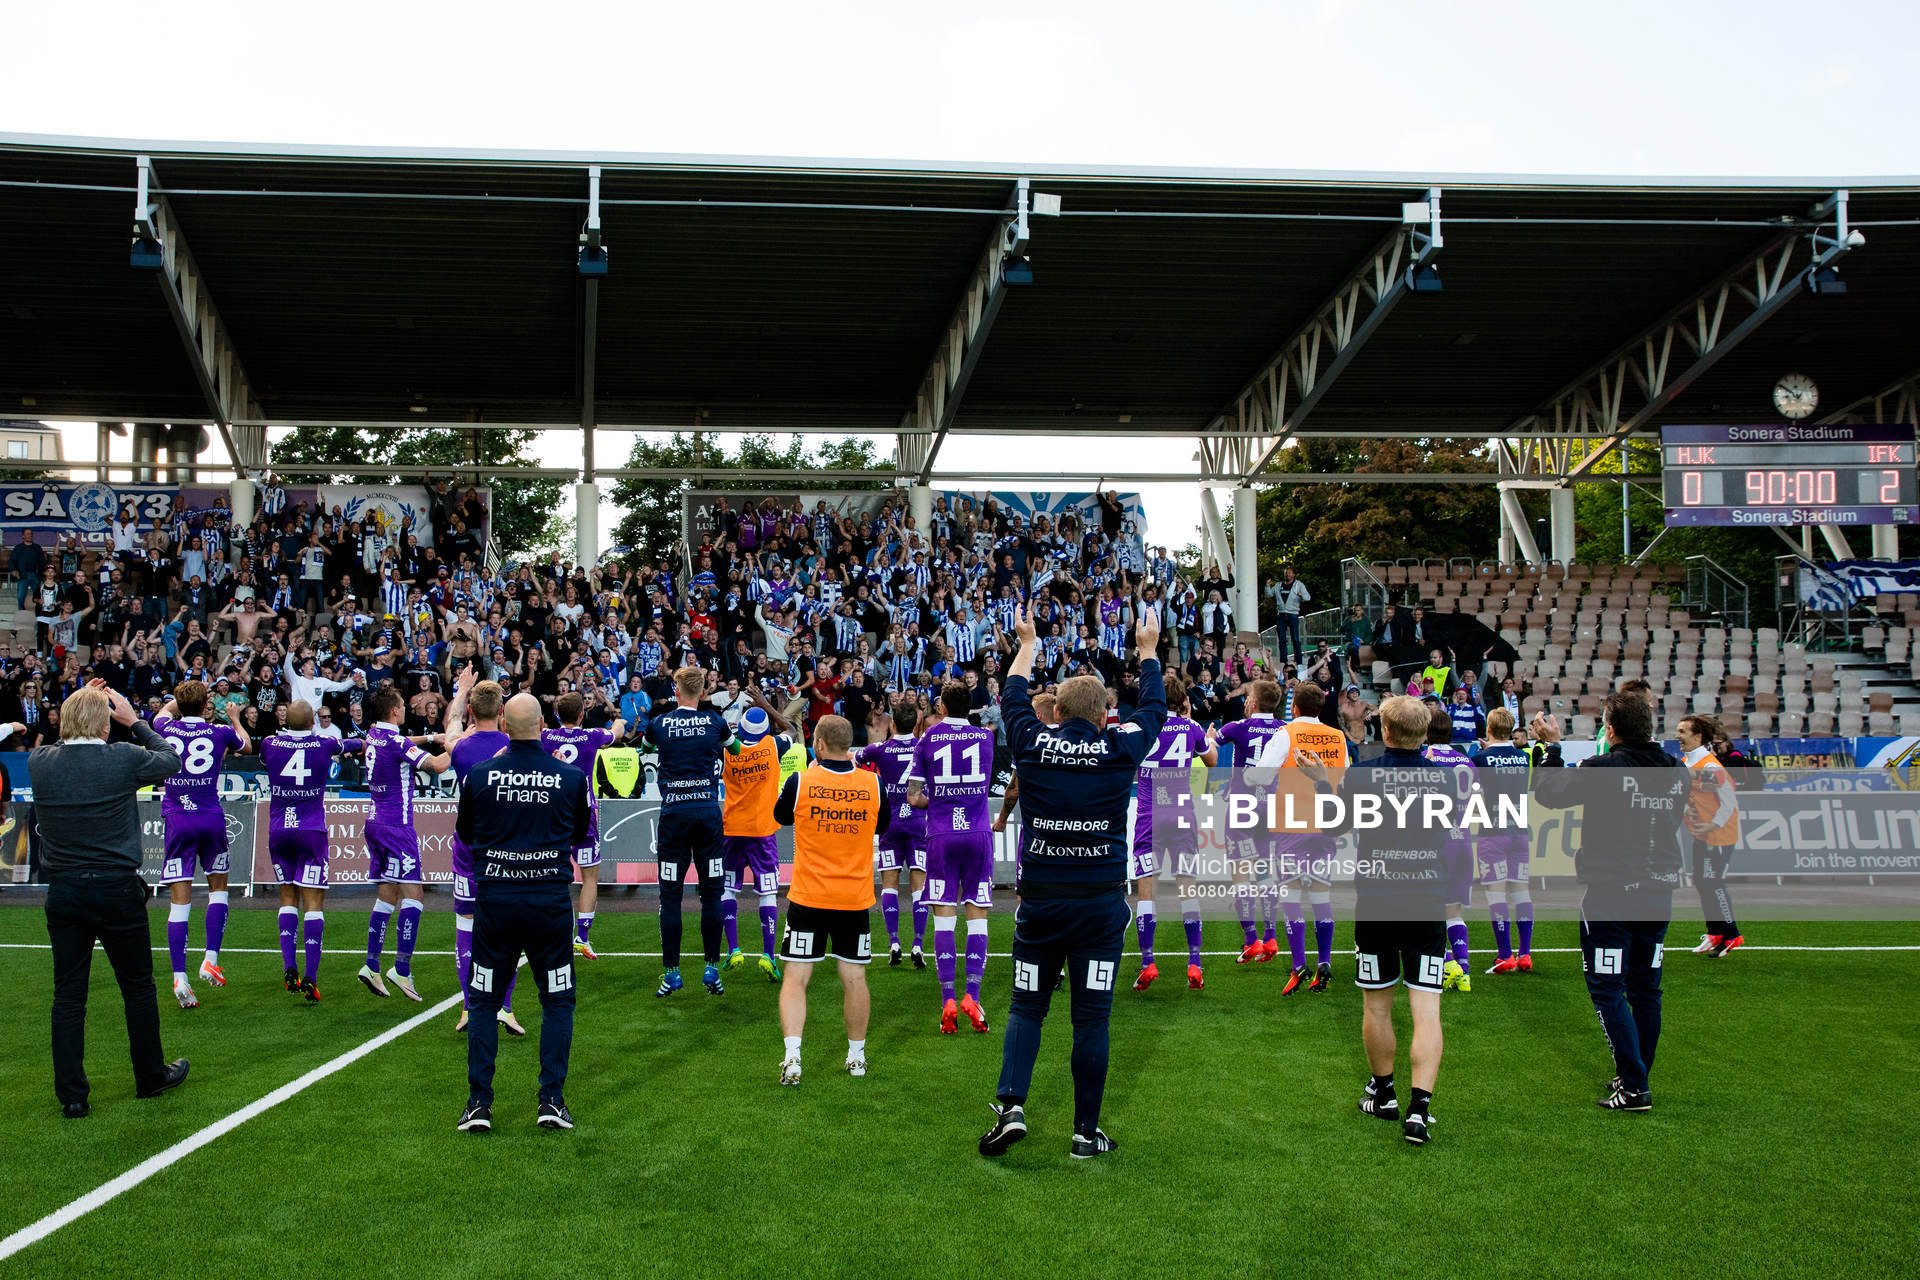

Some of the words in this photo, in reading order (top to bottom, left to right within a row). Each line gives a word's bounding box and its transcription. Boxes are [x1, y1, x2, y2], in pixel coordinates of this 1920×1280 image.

[1728, 427, 1784, 440] Sonera
[1788, 426, 1854, 439] Stadium
[1678, 447, 1715, 464] HJK
[1868, 445, 1902, 463] IFK
[1683, 472, 1702, 505] 0
[1745, 471, 1836, 505] 90:00
[1880, 470, 1899, 503] 2
[5, 484, 66, 517] SÄ
[1732, 510, 1788, 523] Sonera
[1791, 509, 1857, 523] Stadium
[662, 715, 712, 727] Prioritet
[164, 726, 213, 737] EHRENBORG
[546, 733, 588, 742] EHRENBORG
[668, 726, 706, 738] Finans
[931, 732, 987, 742] EHRENBORG
[1296, 733, 1341, 745] Kappa
[271, 739, 321, 748] EHRENBORG
[1035, 732, 1108, 755] Prioritet
[1140, 733, 1191, 768] 24
[365, 745, 376, 780] 9
[934, 742, 986, 784] 11
[1040, 748, 1099, 766] Finans
[1487, 756, 1528, 765] Prioritet
[1765, 755, 1832, 769] BEACH
[280, 749, 312, 786] 4
[731, 761, 770, 776] Prioritet
[897, 754, 914, 784] 7
[1496, 764, 1525, 774] Finans
[487, 770, 562, 789] Prioritet
[1371, 768, 1447, 784] Prioritet
[496, 785, 549, 804] Finans
[808, 786, 870, 802] Kappa
[1631, 792, 1674, 810] Finans
[810, 806, 868, 821] Prioritet
[817, 820, 859, 835] Finans
[1033, 817, 1110, 831] EHRENBORG
[486, 849, 559, 861] EHRENBORG
[1794, 853, 1825, 868] Join
[1828, 853, 1857, 867] the
